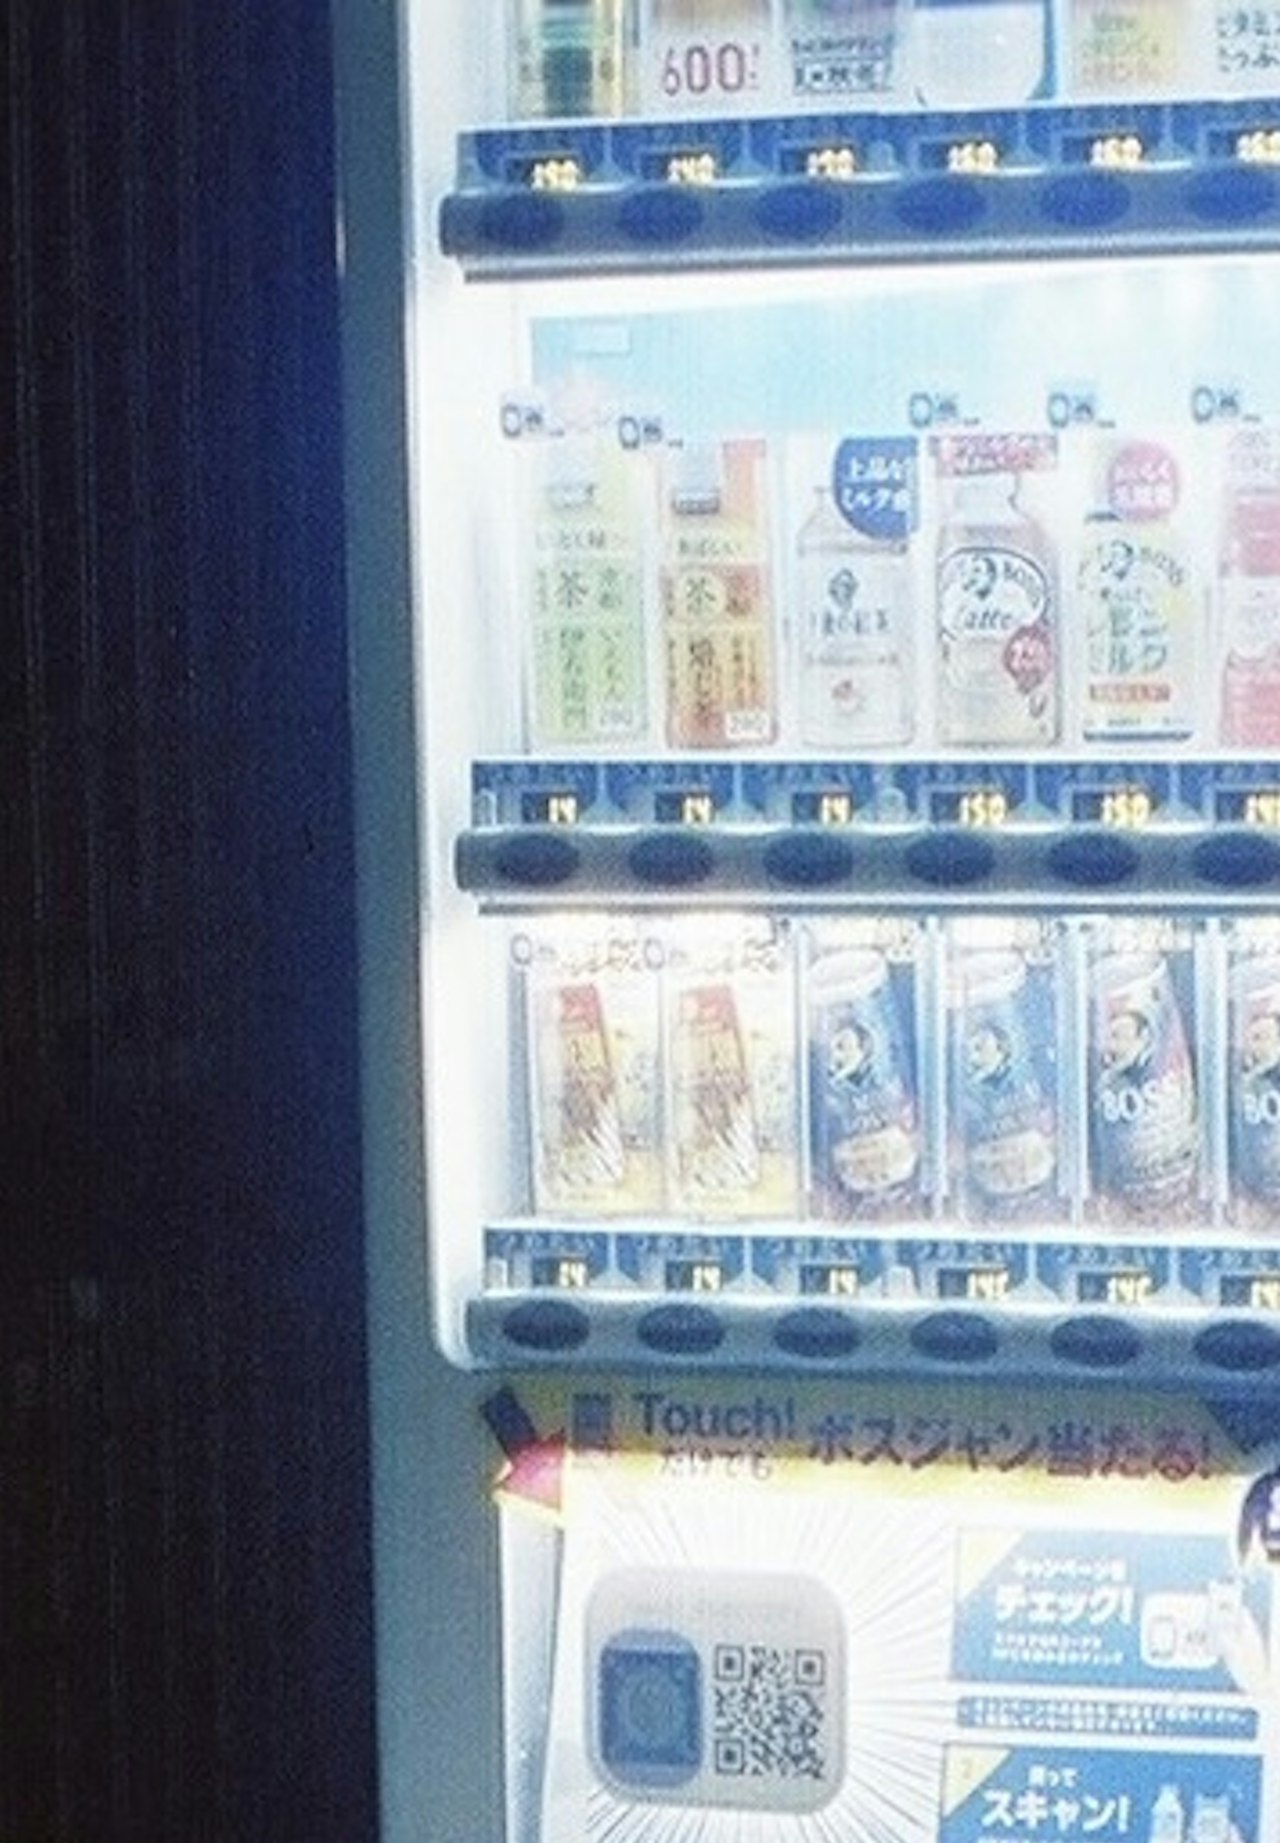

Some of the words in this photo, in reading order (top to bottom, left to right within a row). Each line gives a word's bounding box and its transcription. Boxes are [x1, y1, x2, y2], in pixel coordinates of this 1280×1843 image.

[637, 1392, 796, 1438] Touch!
[993, 1583, 1134, 1626] チェック!
[981, 1788, 1131, 1833] スキャン!
